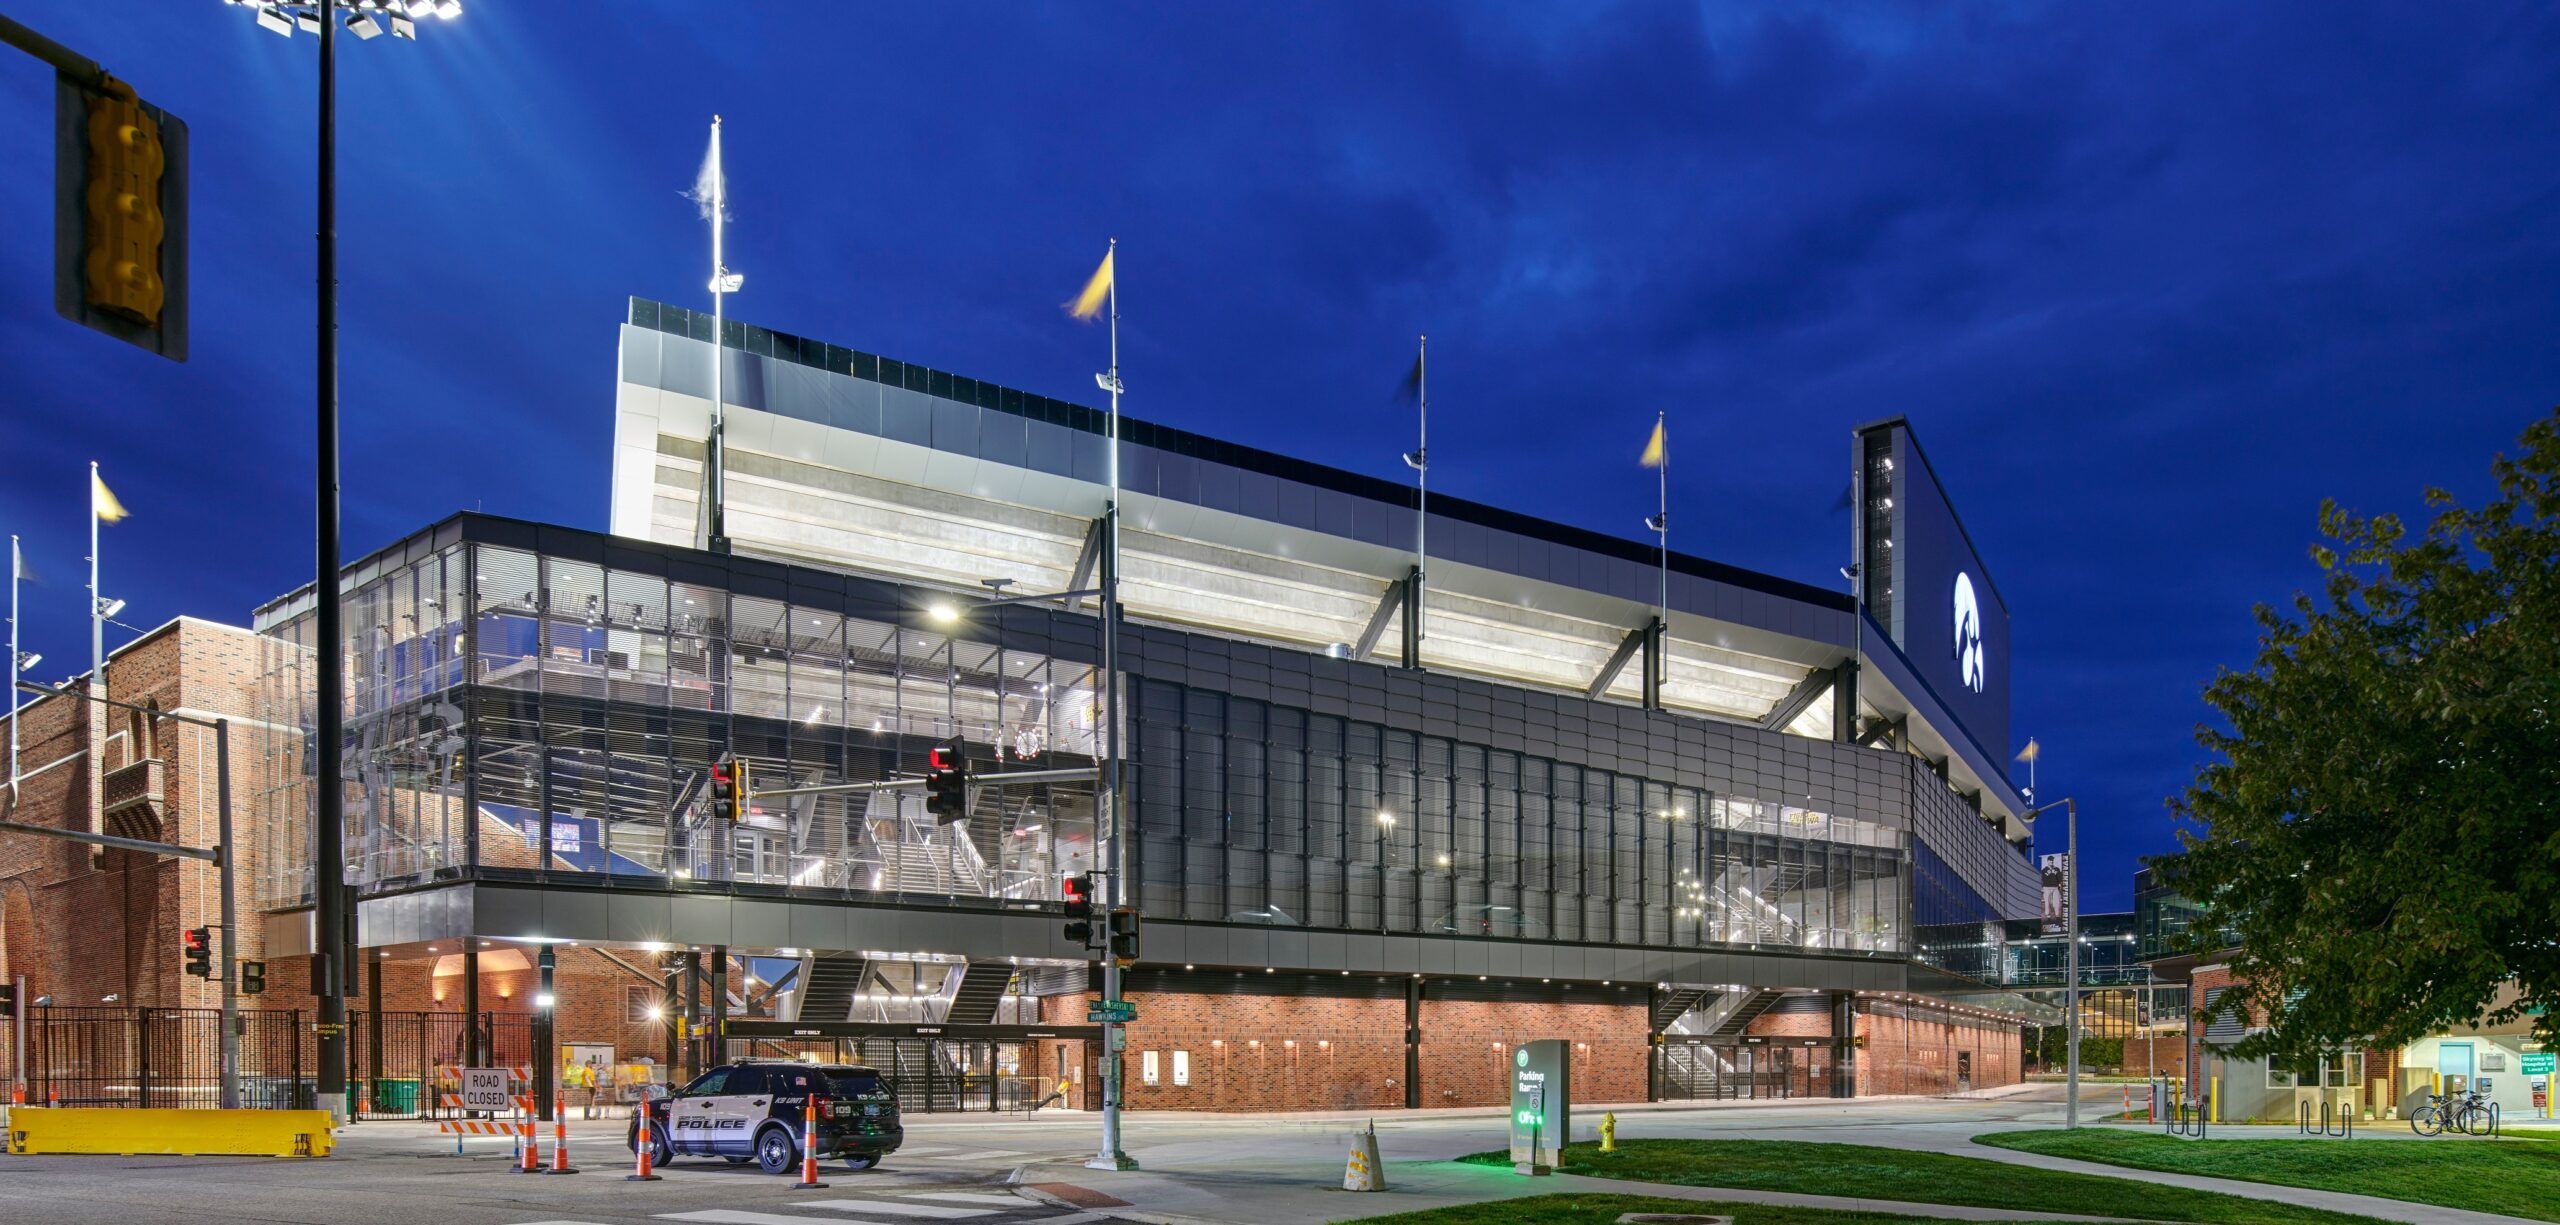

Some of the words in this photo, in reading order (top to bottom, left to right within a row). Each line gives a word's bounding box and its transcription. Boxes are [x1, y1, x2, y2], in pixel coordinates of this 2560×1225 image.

[1090, 1012, 1117, 1021] HAWKINS
[473, 1075, 499, 1087] ROAD
[1519, 1071, 1544, 1082] Parking
[468, 1092, 505, 1105] CLOSED
[835, 1106, 851, 1114] 109
[677, 1120, 745, 1129] POLICE
